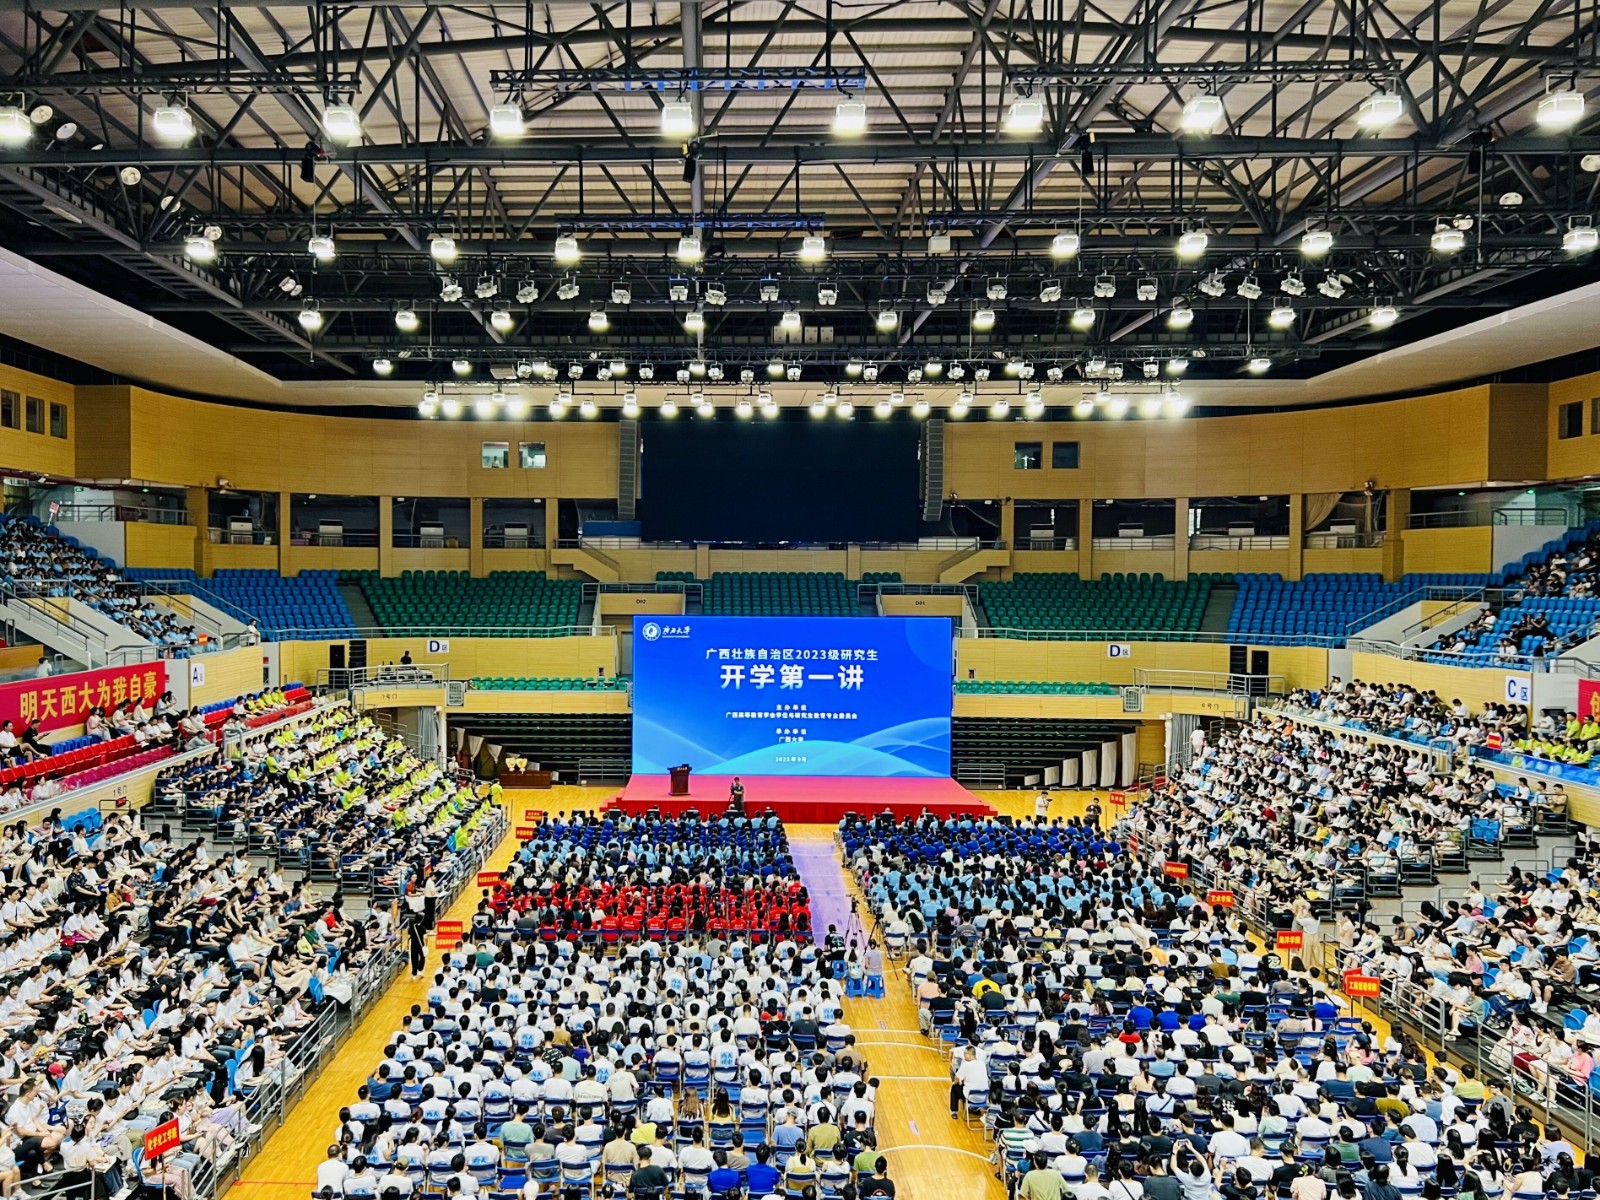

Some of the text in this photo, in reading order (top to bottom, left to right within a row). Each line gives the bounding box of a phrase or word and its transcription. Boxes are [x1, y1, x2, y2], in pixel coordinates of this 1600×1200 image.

[706, 648, 878, 661] 广西壮族自治区2023级研究生
[720, 664, 864, 691] 开学第一讲
[20, 671, 157, 724] 明天西大为我自豪
[1508, 680, 1528, 701] C区
[1349, 982, 1377, 992] 工商管理学院
[148, 1127, 177, 1151] 化学化工学院
